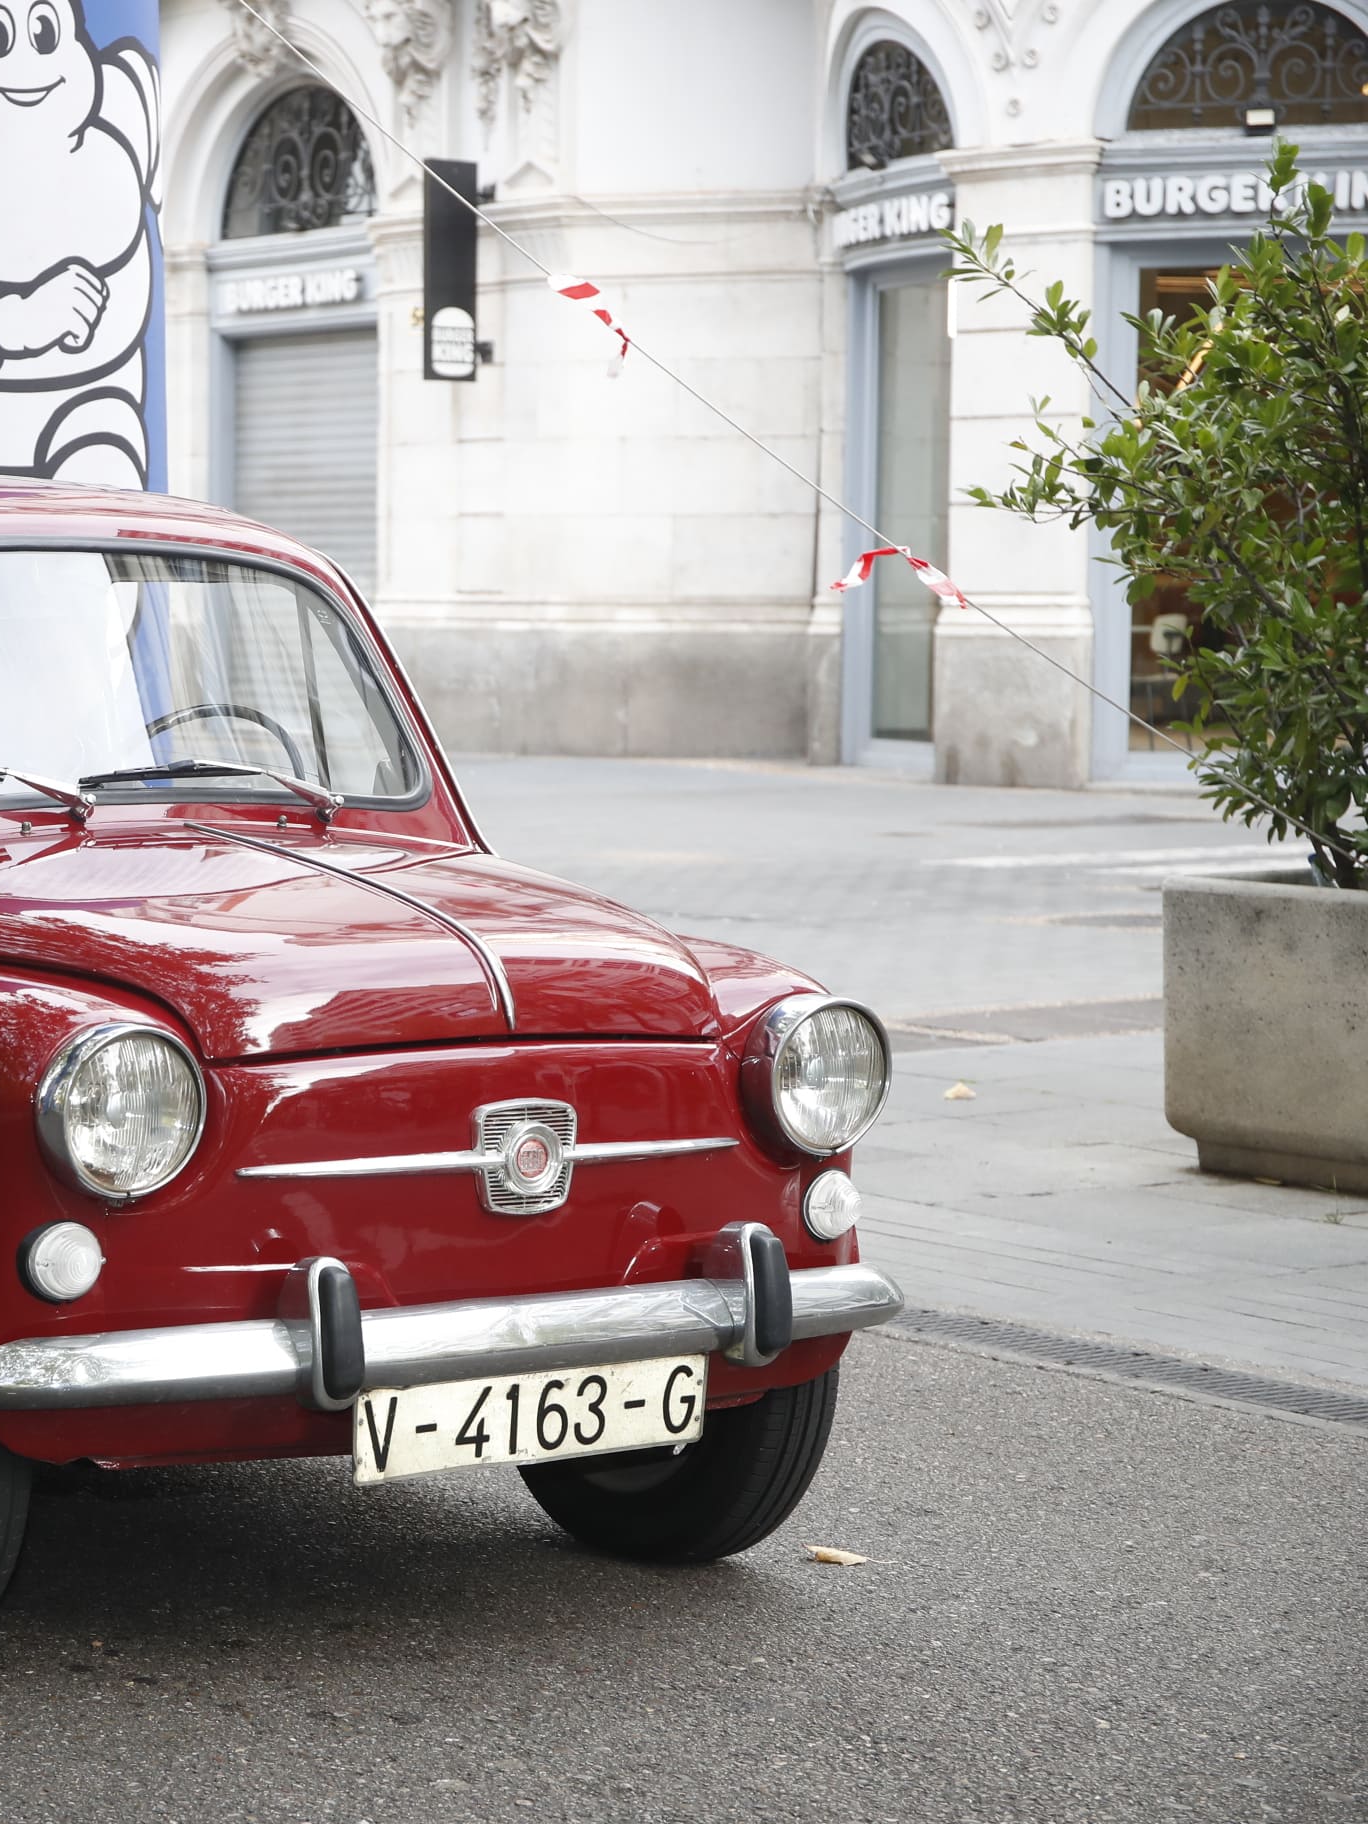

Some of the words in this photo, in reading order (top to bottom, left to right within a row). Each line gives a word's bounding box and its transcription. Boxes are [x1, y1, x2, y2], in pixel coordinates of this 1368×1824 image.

[883, 192, 951, 236] KING
[1104, 172, 1288, 219] BURGER
[224, 275, 303, 311] BURGER
[305, 269, 357, 304] KING
[364, 1365, 697, 1473] V-4163-G
